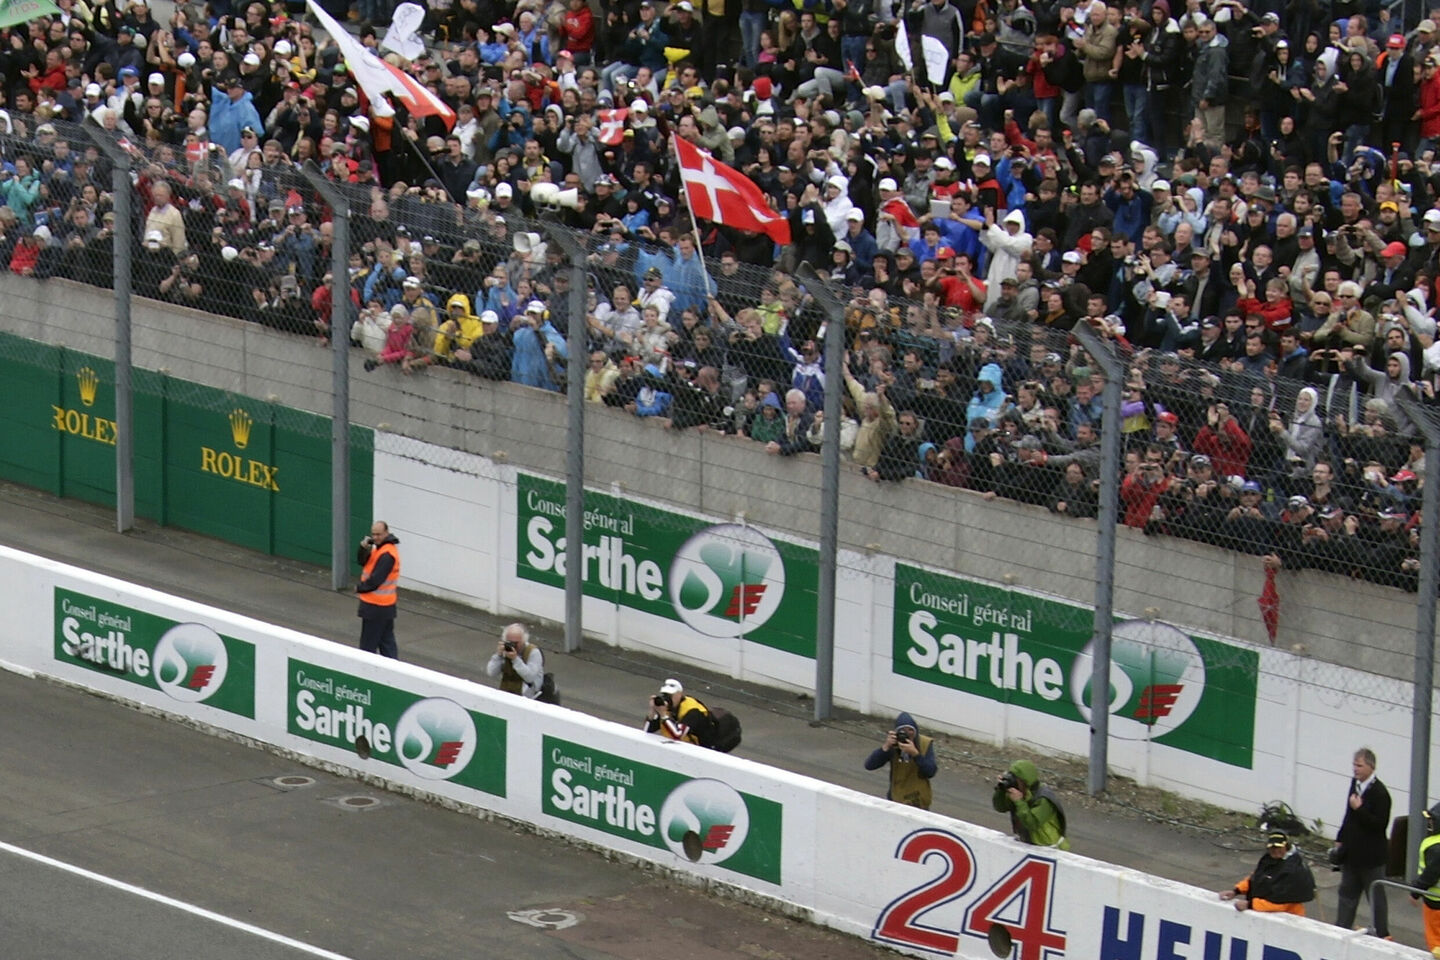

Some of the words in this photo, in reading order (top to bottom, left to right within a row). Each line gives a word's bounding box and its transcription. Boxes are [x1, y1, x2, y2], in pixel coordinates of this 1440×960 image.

[201, 447, 280, 492] ROLEX
[62, 598, 96, 622] Conseil
[97, 609, 132, 633] général
[909, 582, 968, 618] Conseil
[973, 603, 1032, 633] général
[61, 617, 150, 677] Sarthe
[906, 610, 1064, 701] Sarthe
[296, 669, 333, 695] Conseil
[335, 682, 372, 707] général
[295, 689, 392, 754] Sarthe
[552, 748, 592, 774] Conseil
[594, 763, 635, 787] général
[551, 768, 656, 836] Sarthe
